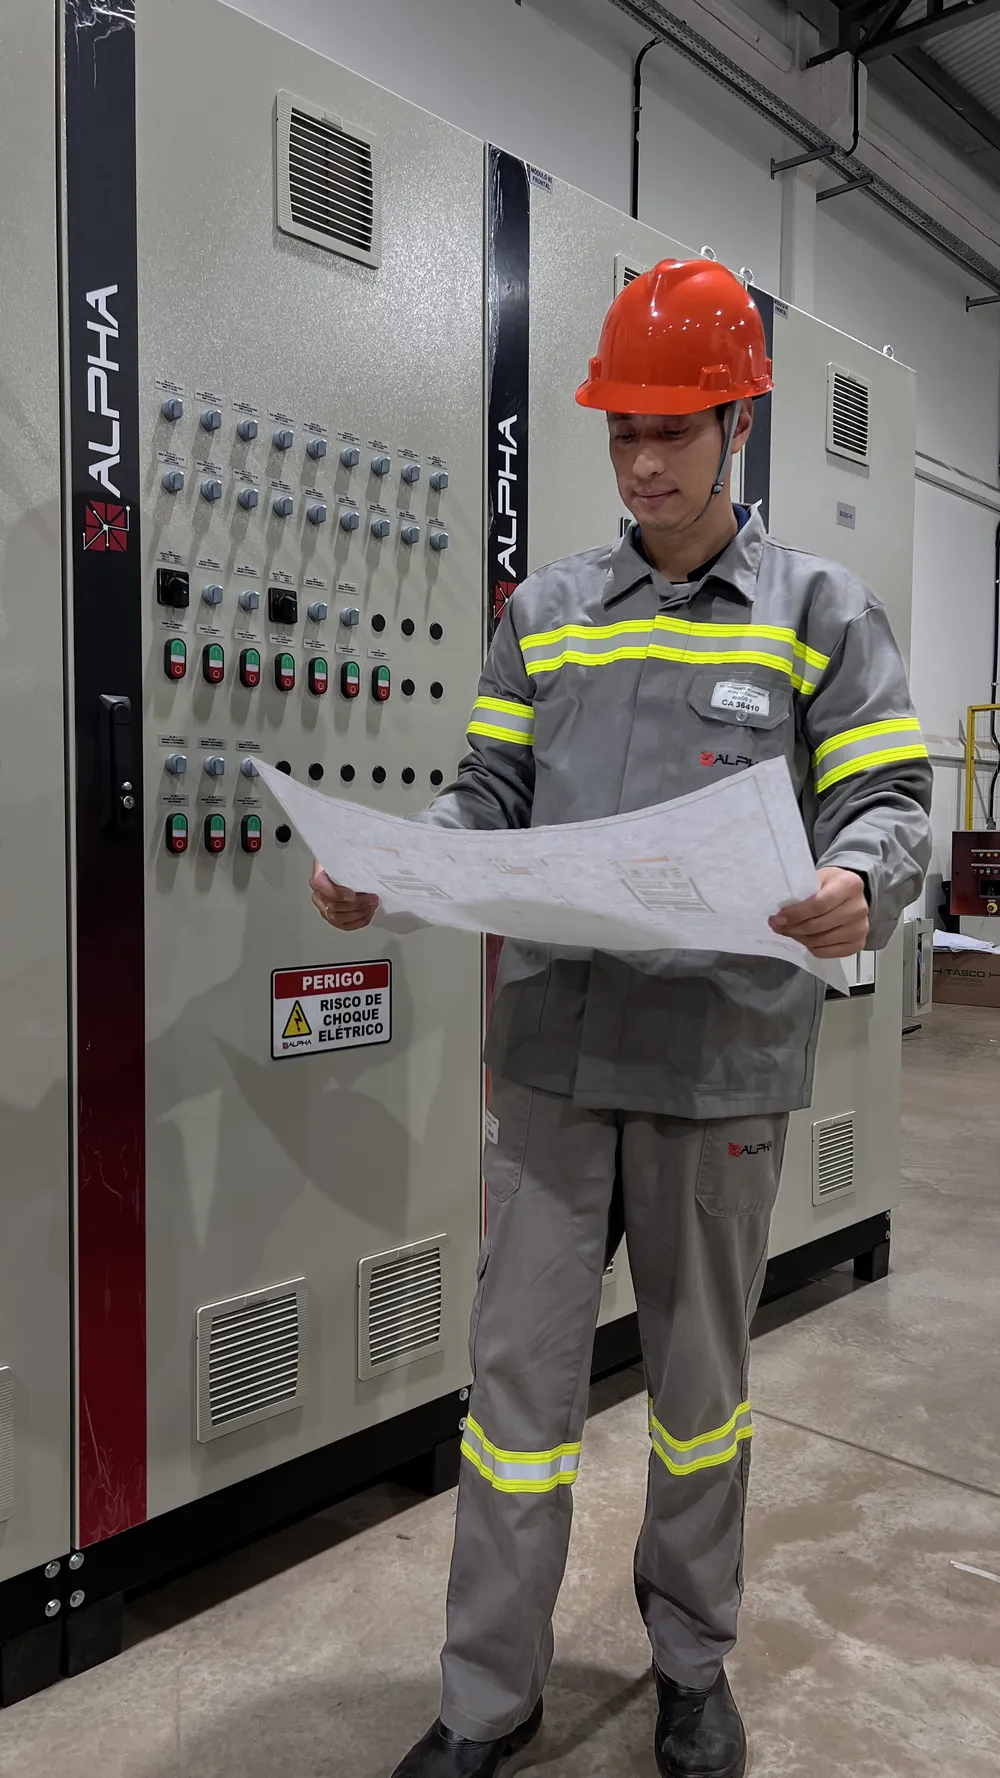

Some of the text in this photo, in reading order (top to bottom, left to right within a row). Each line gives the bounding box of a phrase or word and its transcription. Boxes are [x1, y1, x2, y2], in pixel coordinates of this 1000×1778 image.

[533, 176, 551, 190] FRONTAL
[85, 284, 121, 499] ALPHA
[497, 414, 518, 578] ALPHA
[721, 699, 760, 712] CA 36410
[712, 754, 759, 768] ALPH
[302, 971, 364, 991] PERIGO
[945, 968, 985, 977] TASCO
[320, 993, 382, 1012] RISCO DE
[323, 1008, 380, 1026] CHOQUE
[318, 1023, 383, 1042] ELÉTRICO
[288, 1039, 312, 1048] ALPHA
